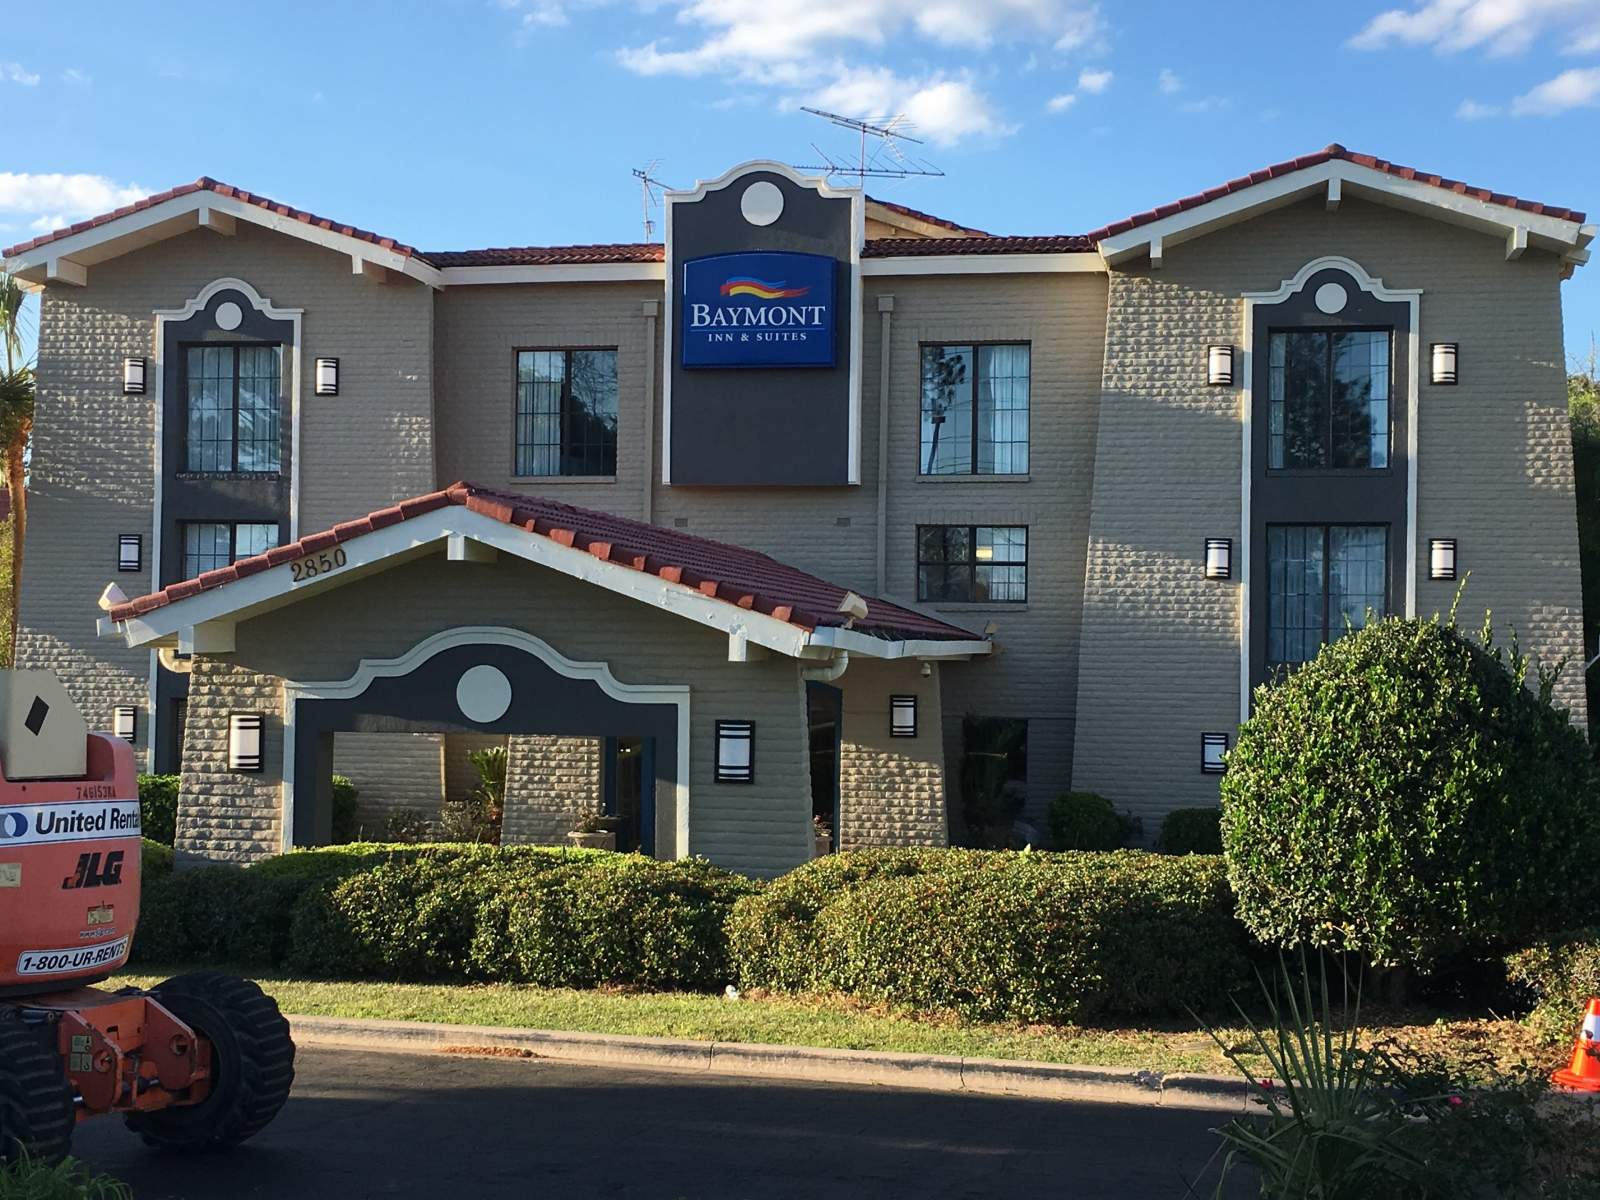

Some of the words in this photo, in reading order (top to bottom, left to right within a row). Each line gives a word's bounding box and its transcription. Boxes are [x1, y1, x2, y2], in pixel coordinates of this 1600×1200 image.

[690, 303, 826, 327] BAYMONT
[708, 333, 734, 342] INN
[740, 332, 749, 341] &
[756, 332, 807, 341] SUITES
[291, 548, 347, 582] 2850
[35, 808, 107, 835] United
[62, 850, 125, 890] JLG
